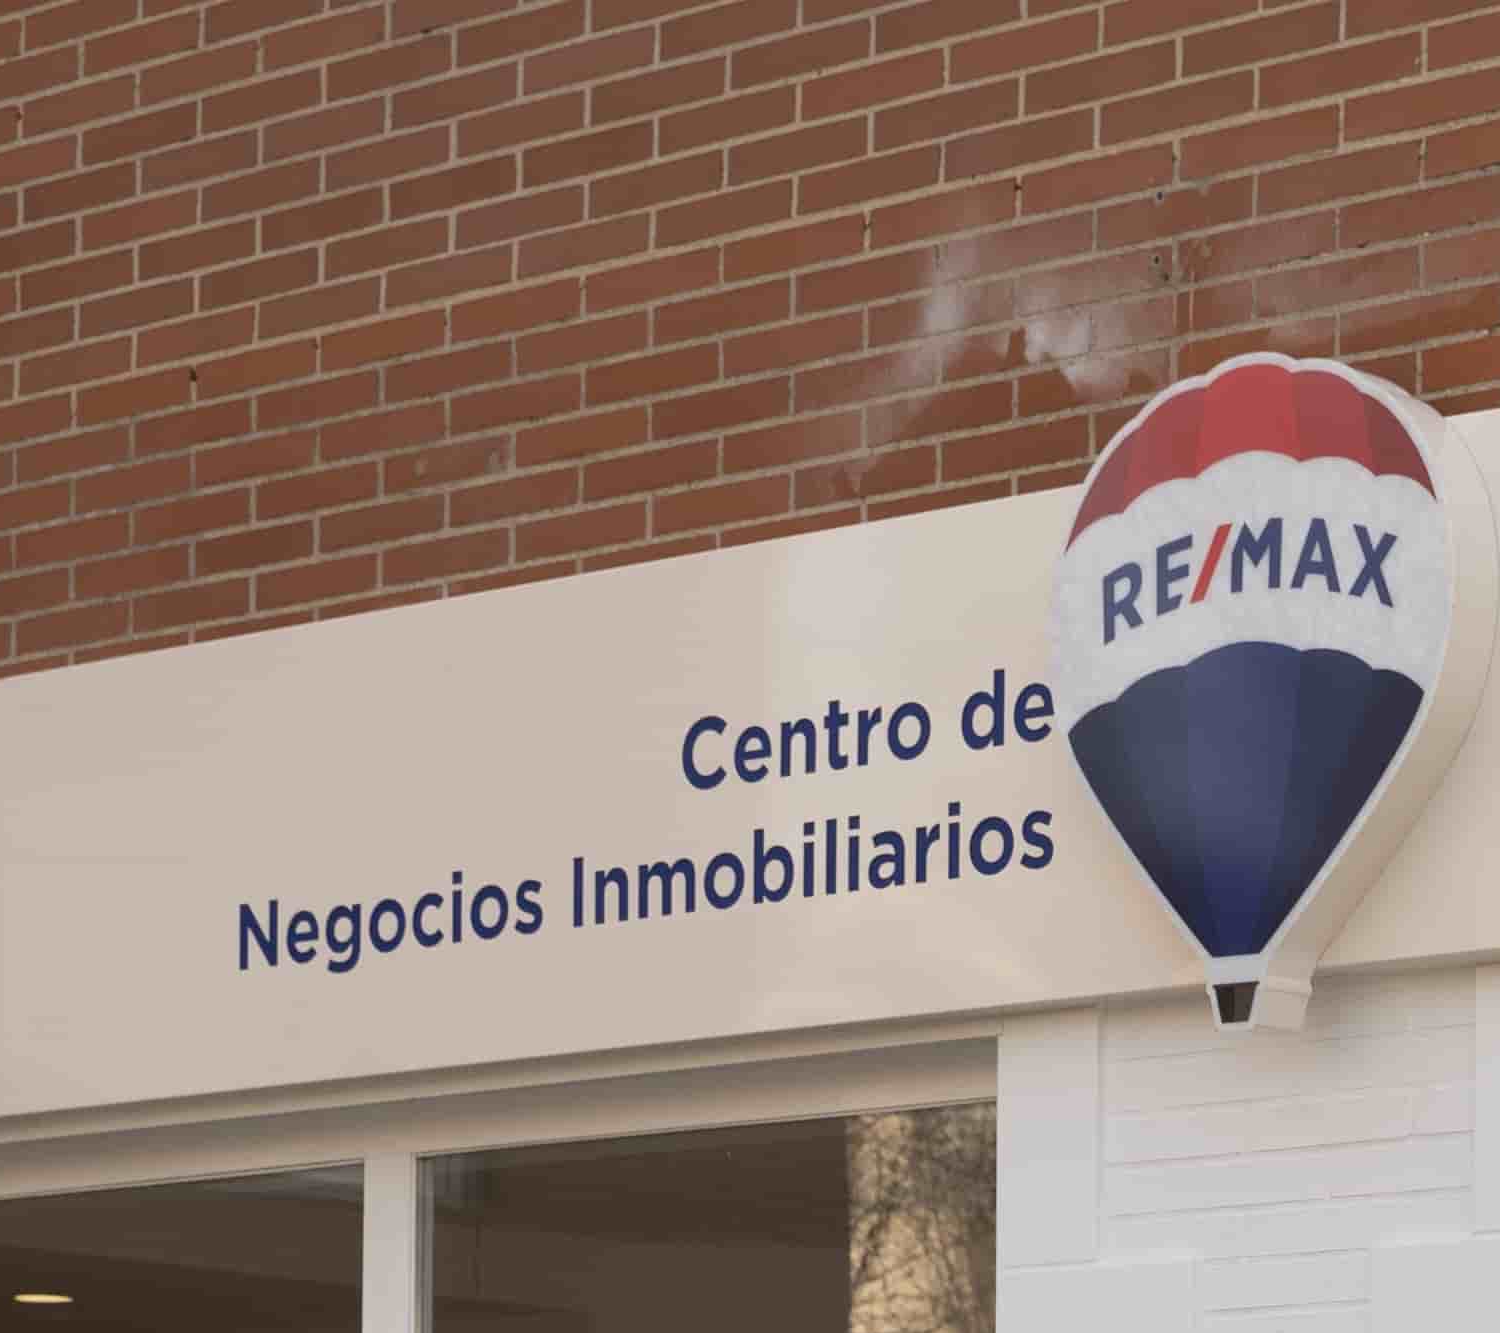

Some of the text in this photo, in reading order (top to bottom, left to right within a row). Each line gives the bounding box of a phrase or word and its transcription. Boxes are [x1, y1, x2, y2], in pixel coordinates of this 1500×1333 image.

[1102, 516, 1398, 646] RE/MAX
[680, 668, 1057, 790] Centro de
[236, 799, 1057, 974] Negocios Inmobiliarios
